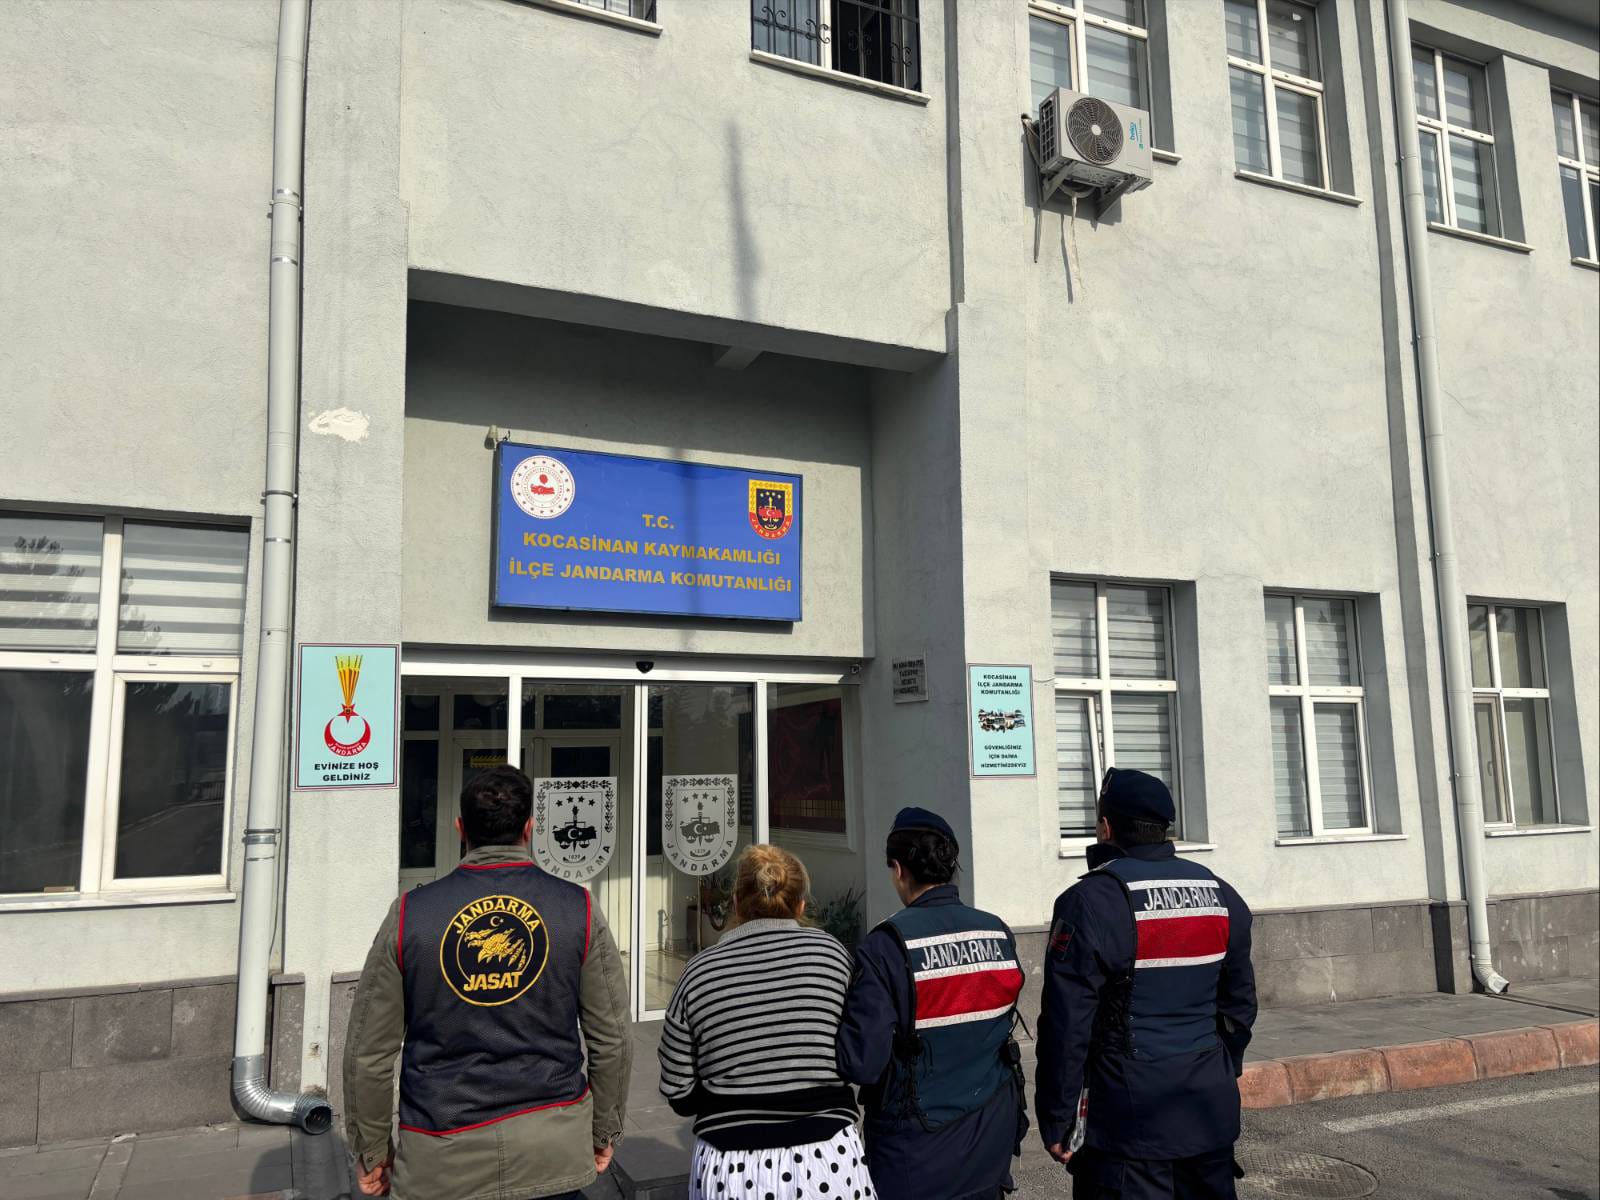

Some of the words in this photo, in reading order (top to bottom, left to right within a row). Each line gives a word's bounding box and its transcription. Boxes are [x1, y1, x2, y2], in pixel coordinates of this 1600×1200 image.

[641, 514, 675, 529] T.C.
[523, 532, 638, 554] KOCASİNAN
[644, 542, 781, 565] KAYMAKAMLIĞI
[509, 557, 555, 579] İLÇE
[560, 564, 665, 584] JANDARMA
[671, 571, 792, 592] KOMUTANLIĞI
[327, 742, 367, 756] JANDARMA
[314, 762, 356, 770] EVİNİZE
[358, 762, 379, 770] HOŞ
[322, 773, 371, 781] GELDİNİZ
[538, 845, 611, 879] JANDARMA
[667, 840, 734, 872] JANDARMA
[1143, 887, 1221, 910] JANDARMA
[453, 898, 540, 934] JANDARMA
[921, 939, 1005, 970] JANDARMA
[463, 971, 523, 991] JASAT
